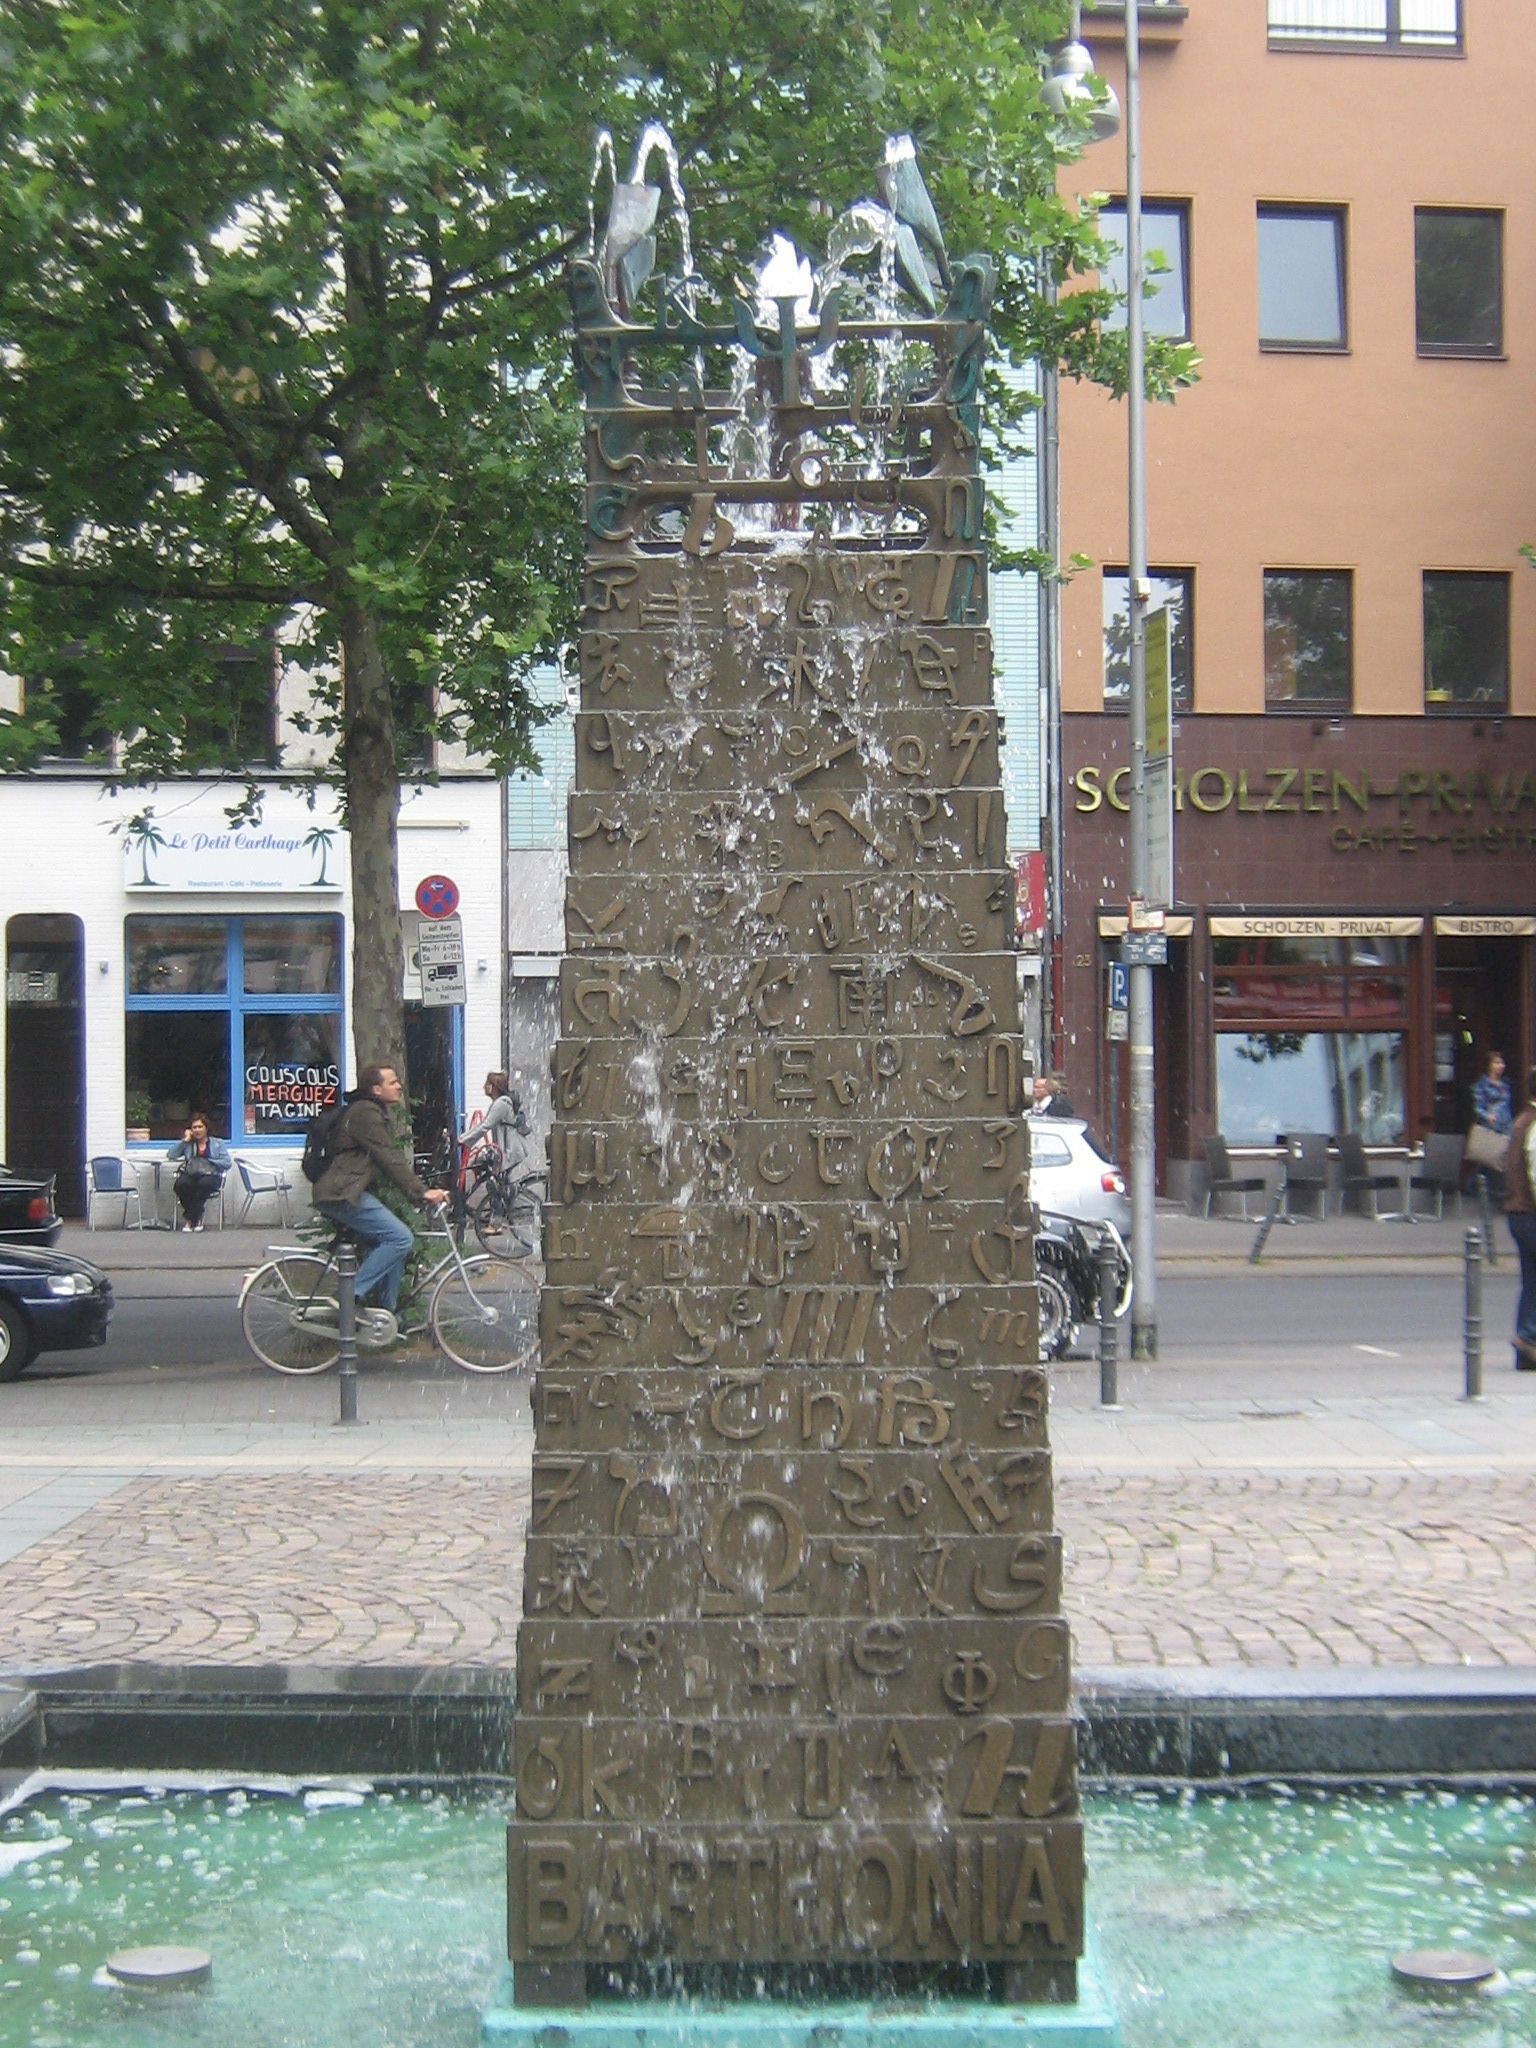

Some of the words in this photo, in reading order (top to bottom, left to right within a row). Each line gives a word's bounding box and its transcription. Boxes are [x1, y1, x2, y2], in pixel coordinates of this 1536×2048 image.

[168, 833, 188, 850] Le
[192, 832, 231, 852] Petit
[234, 833, 303, 853] Carthage
[1243, 921, 1326, 934] SCHOLZEN
[1340, 921, 1394, 934] PRIVAT
[1459, 920, 1515, 934] BISTRO
[1114, 969, 1125, 1002] P
[246, 1065, 340, 1086] COUSCOUS
[251, 1084, 335, 1104] MERGUEZ
[523, 1834, 1068, 1953] BARTHONIA
